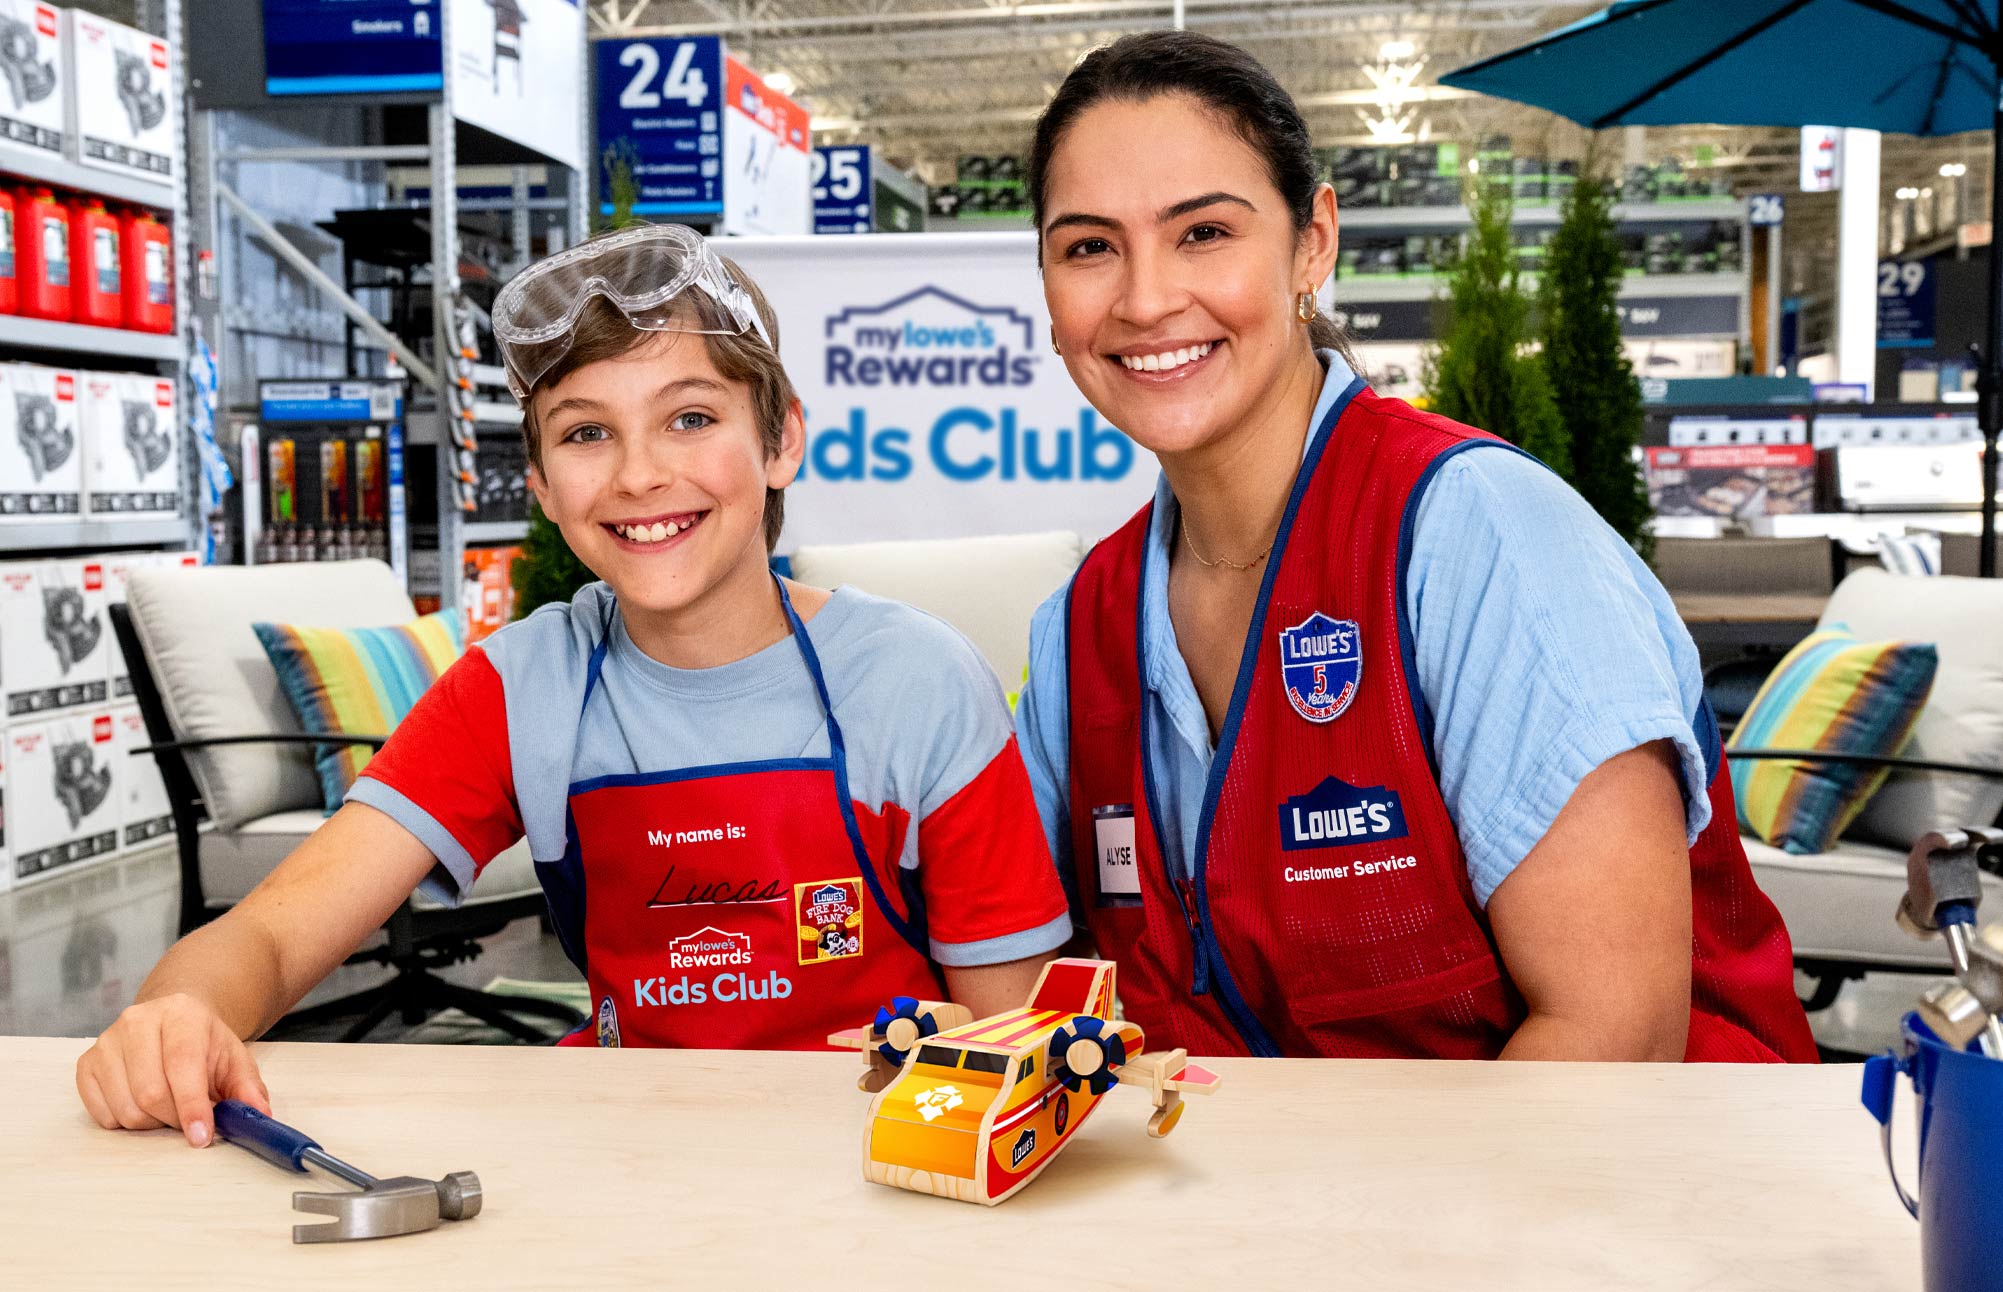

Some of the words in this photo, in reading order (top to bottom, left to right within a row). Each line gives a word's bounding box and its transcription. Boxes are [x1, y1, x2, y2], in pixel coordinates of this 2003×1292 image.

[619, 42, 708, 108] 24
[811, 150, 862, 200] 25
[1750, 196, 1783, 223] 26
[1877, 262, 1925, 296] 29
[855, 320, 995, 350] mylowe's
[825, 345, 1034, 386] Rewards
[928, 406, 1135, 482] Club
[1290, 629, 1351, 658] LOWE'S
[1313, 665, 1327, 695] 5
[1331, 680, 1354, 714] SERVICE
[1292, 800, 1391, 841] LOWE'S
[648, 830, 671, 848] My
[676, 826, 723, 844] name
[726, 823, 746, 839] is:
[1106, 847, 1131, 866] ALYSE
[1284, 866, 1349, 882] Customer
[1353, 855, 1417, 876] Service
[646, 864, 789, 908] Lucas
[817, 891, 844, 902] LOWE'S
[806, 904, 829, 919] FIRE
[833, 903, 854, 915] DOG
[816, 913, 844, 924] BANK
[670, 948, 751, 969] Rewards
[681, 938, 735, 954] mylowe's
[634, 975, 707, 1007] Kids
[712, 970, 792, 1002] Club
[1014, 1136, 1033, 1162] LOWE'S
